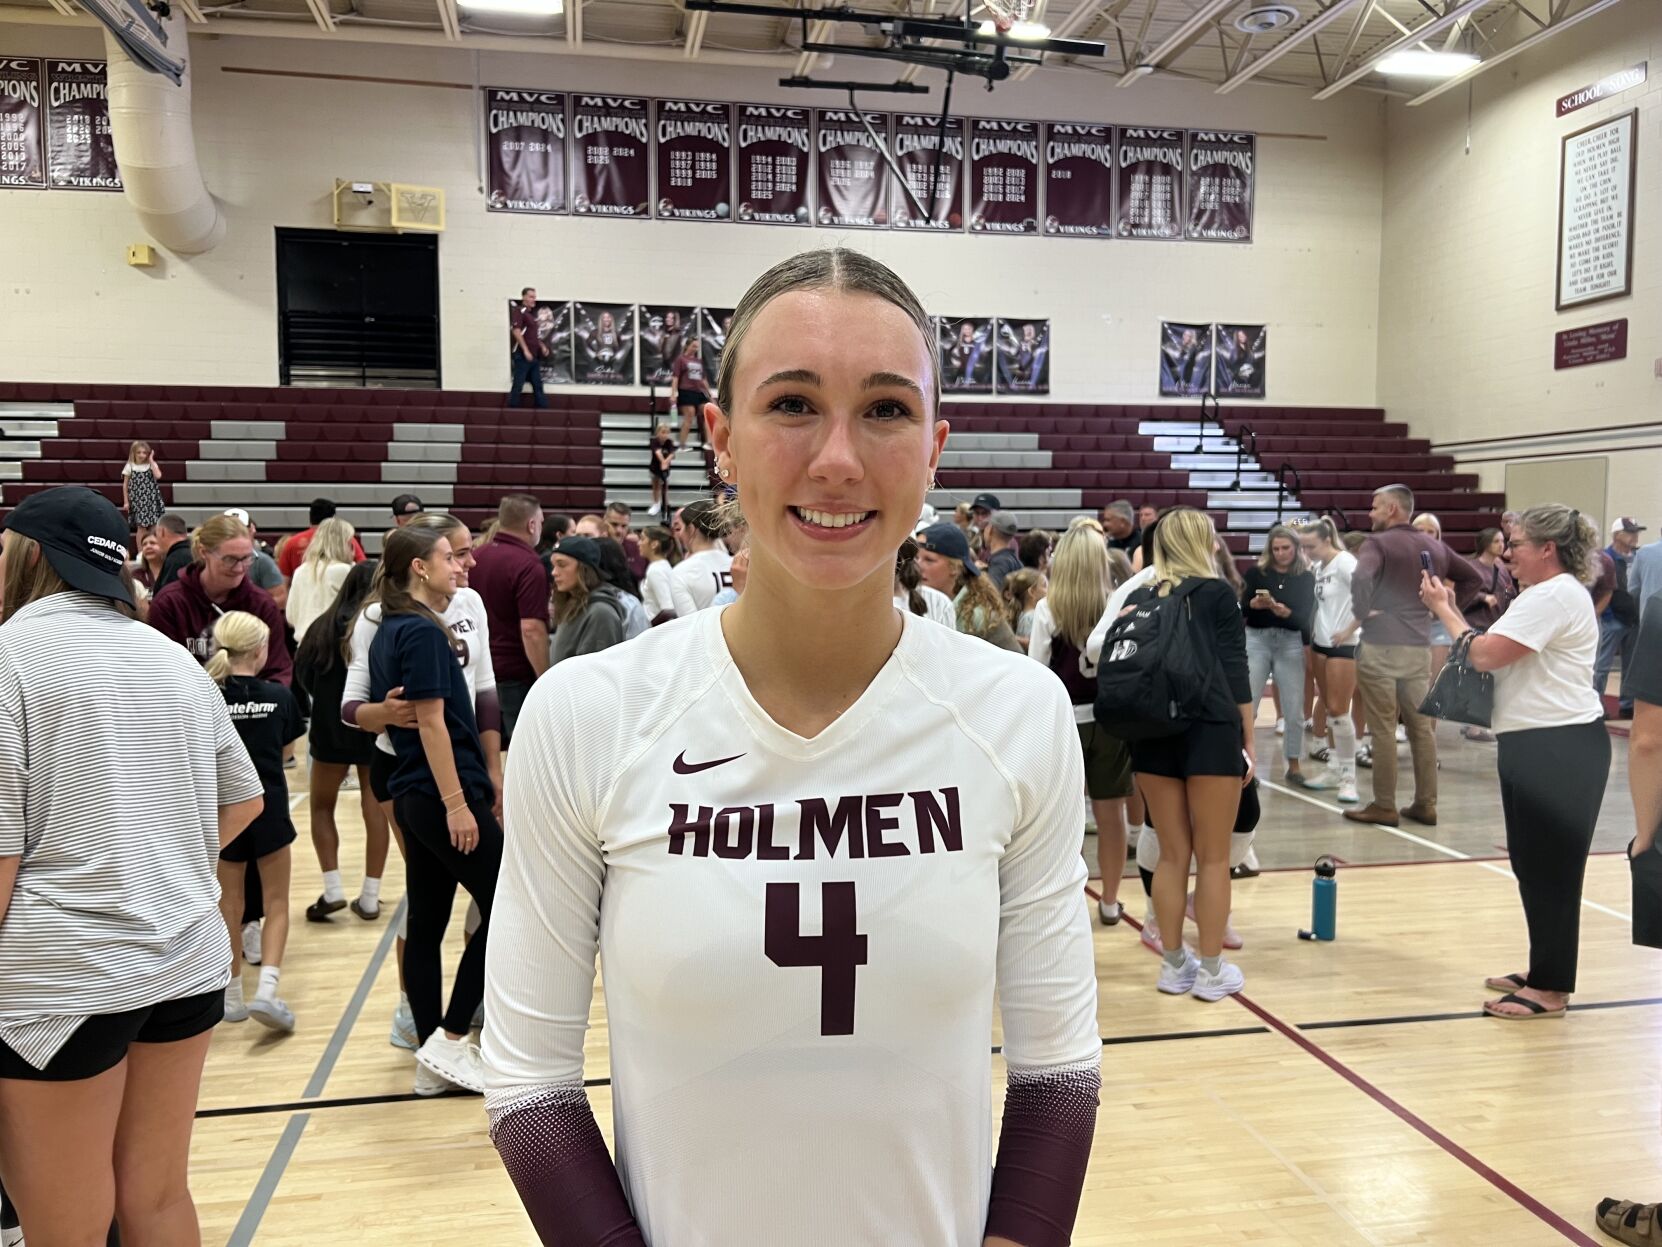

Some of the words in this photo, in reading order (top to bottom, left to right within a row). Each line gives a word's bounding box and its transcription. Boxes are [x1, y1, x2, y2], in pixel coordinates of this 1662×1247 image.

[57, 62, 107, 73] MV
[0, 80, 38, 108] PIONS
[496, 91, 558, 104] MVC
[1561, 85, 1602, 111] SCHOOL
[581, 97, 641, 109] MVC
[664, 102, 724, 114] MVC
[746, 106, 803, 118] MVC
[825, 112, 881, 124] MVC
[490, 110, 564, 139] CHAMPIONS
[574, 115, 648, 143] CHAMPIONS
[978, 121, 1032, 132] MVC
[1054, 125, 1106, 136] MVC
[658, 120, 729, 148] CHAMPIONS
[739, 124, 809, 152] CHAMPIONS
[1126, 129, 1177, 140] MVC
[1198, 133, 1248, 144] MVC
[972, 138, 1038, 165] CHAMPIONS
[1047, 141, 1111, 168] CHAMPIONS
[1120, 146, 1182, 171] CHAMPIONS
[1190, 149, 1251, 174] CHAMPIONS
[2, 162, 26, 170] 2017
[0, 176, 26, 185] NGS
[70, 176, 120, 187] VIKINGS
[506, 200, 551, 210] VIKINGS
[590, 204, 634, 214] VIKINGS
[673, 208, 717, 218] VIKINGS
[753, 212, 796, 222] VIKINGS
[986, 222, 1024, 232] VIKINGS
[1059, 225, 1098, 234] VIKINGS
[1132, 229, 1170, 238] VIKINGS
[1202, 230, 1238, 239] VIKINGS
[88, 536, 116, 550] CEDAR
[668, 787, 963, 860] HOLMEN
[764, 881, 868, 1036] 4
